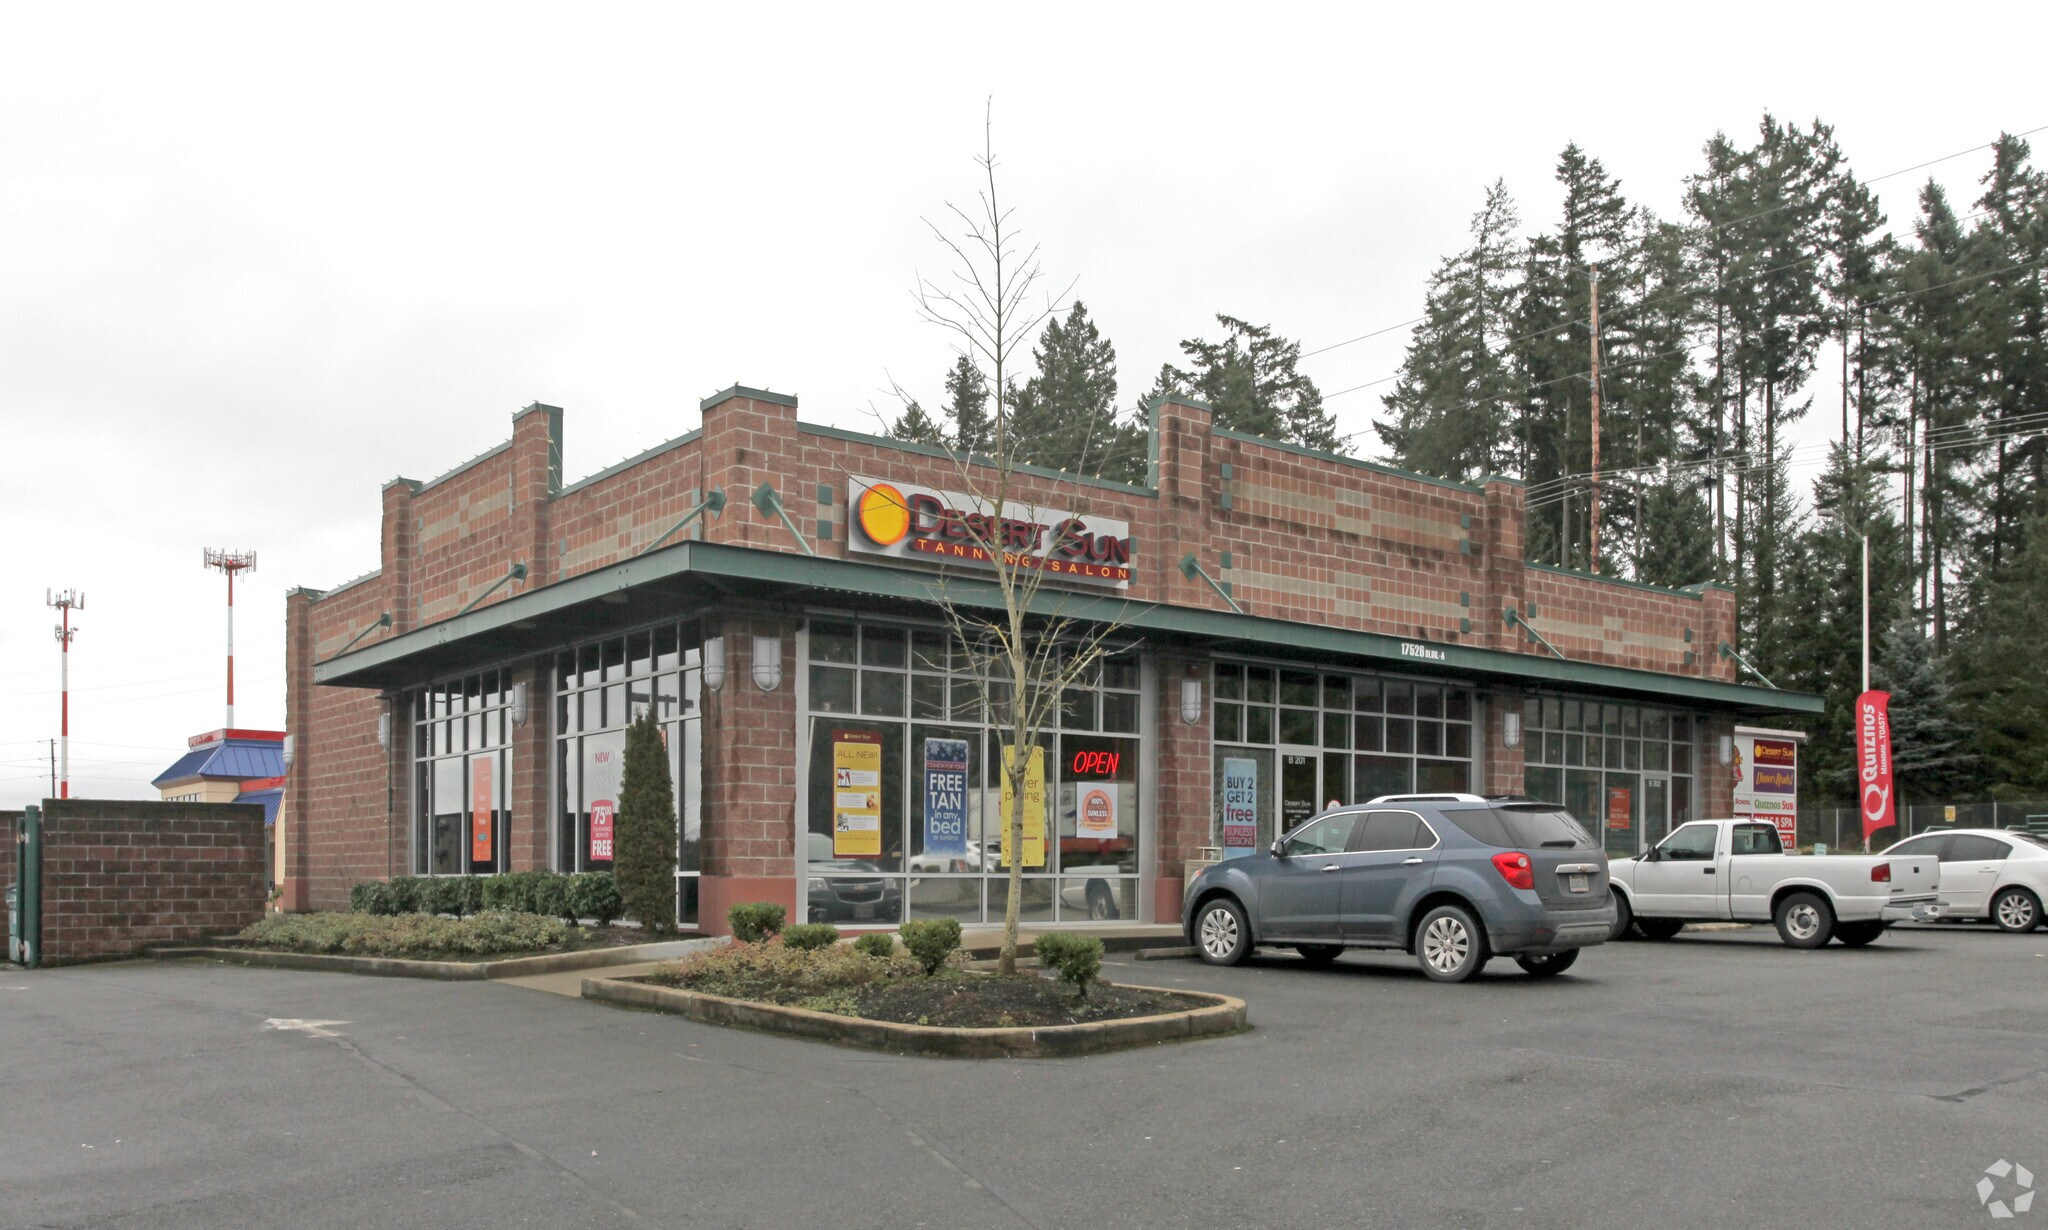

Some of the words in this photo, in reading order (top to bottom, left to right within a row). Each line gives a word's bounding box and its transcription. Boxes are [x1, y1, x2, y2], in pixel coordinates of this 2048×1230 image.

[913, 493, 1050, 549] DESERT
[1058, 518, 1130, 563] SUN
[917, 538, 1033, 567] TANNING
[1051, 560, 1128, 579] SALON
[1862, 703, 1878, 782] QUIZNOS
[595, 752, 610, 763] NEW
[837, 750, 855, 759] ALL
[856, 751, 878, 760] NEW!
[1294, 756, 1305, 764] 201
[1073, 751, 1121, 774] OPEN
[929, 774, 963, 792] FREE
[1008, 778, 1039, 789] ler
[1226, 776, 1245, 790] BUY
[1247, 777, 1254, 790] 2
[930, 792, 962, 810] TAN
[1005, 791, 1040, 803] ping
[1226, 791, 1246, 803] GET
[1247, 792, 1253, 803] 2
[1754, 799, 1781, 810] QUIZNOS
[1781, 801, 1794, 811] SUB
[934, 810, 942, 819] in
[943, 811, 959, 821] any
[1226, 804, 1254, 821] free
[930, 817, 961, 835] bed
[1780, 816, 1793, 828] SPA
[1227, 827, 1253, 836] SUNLESS
[1227, 837, 1254, 846] SESSIONS
[592, 840, 612, 856] FREE
